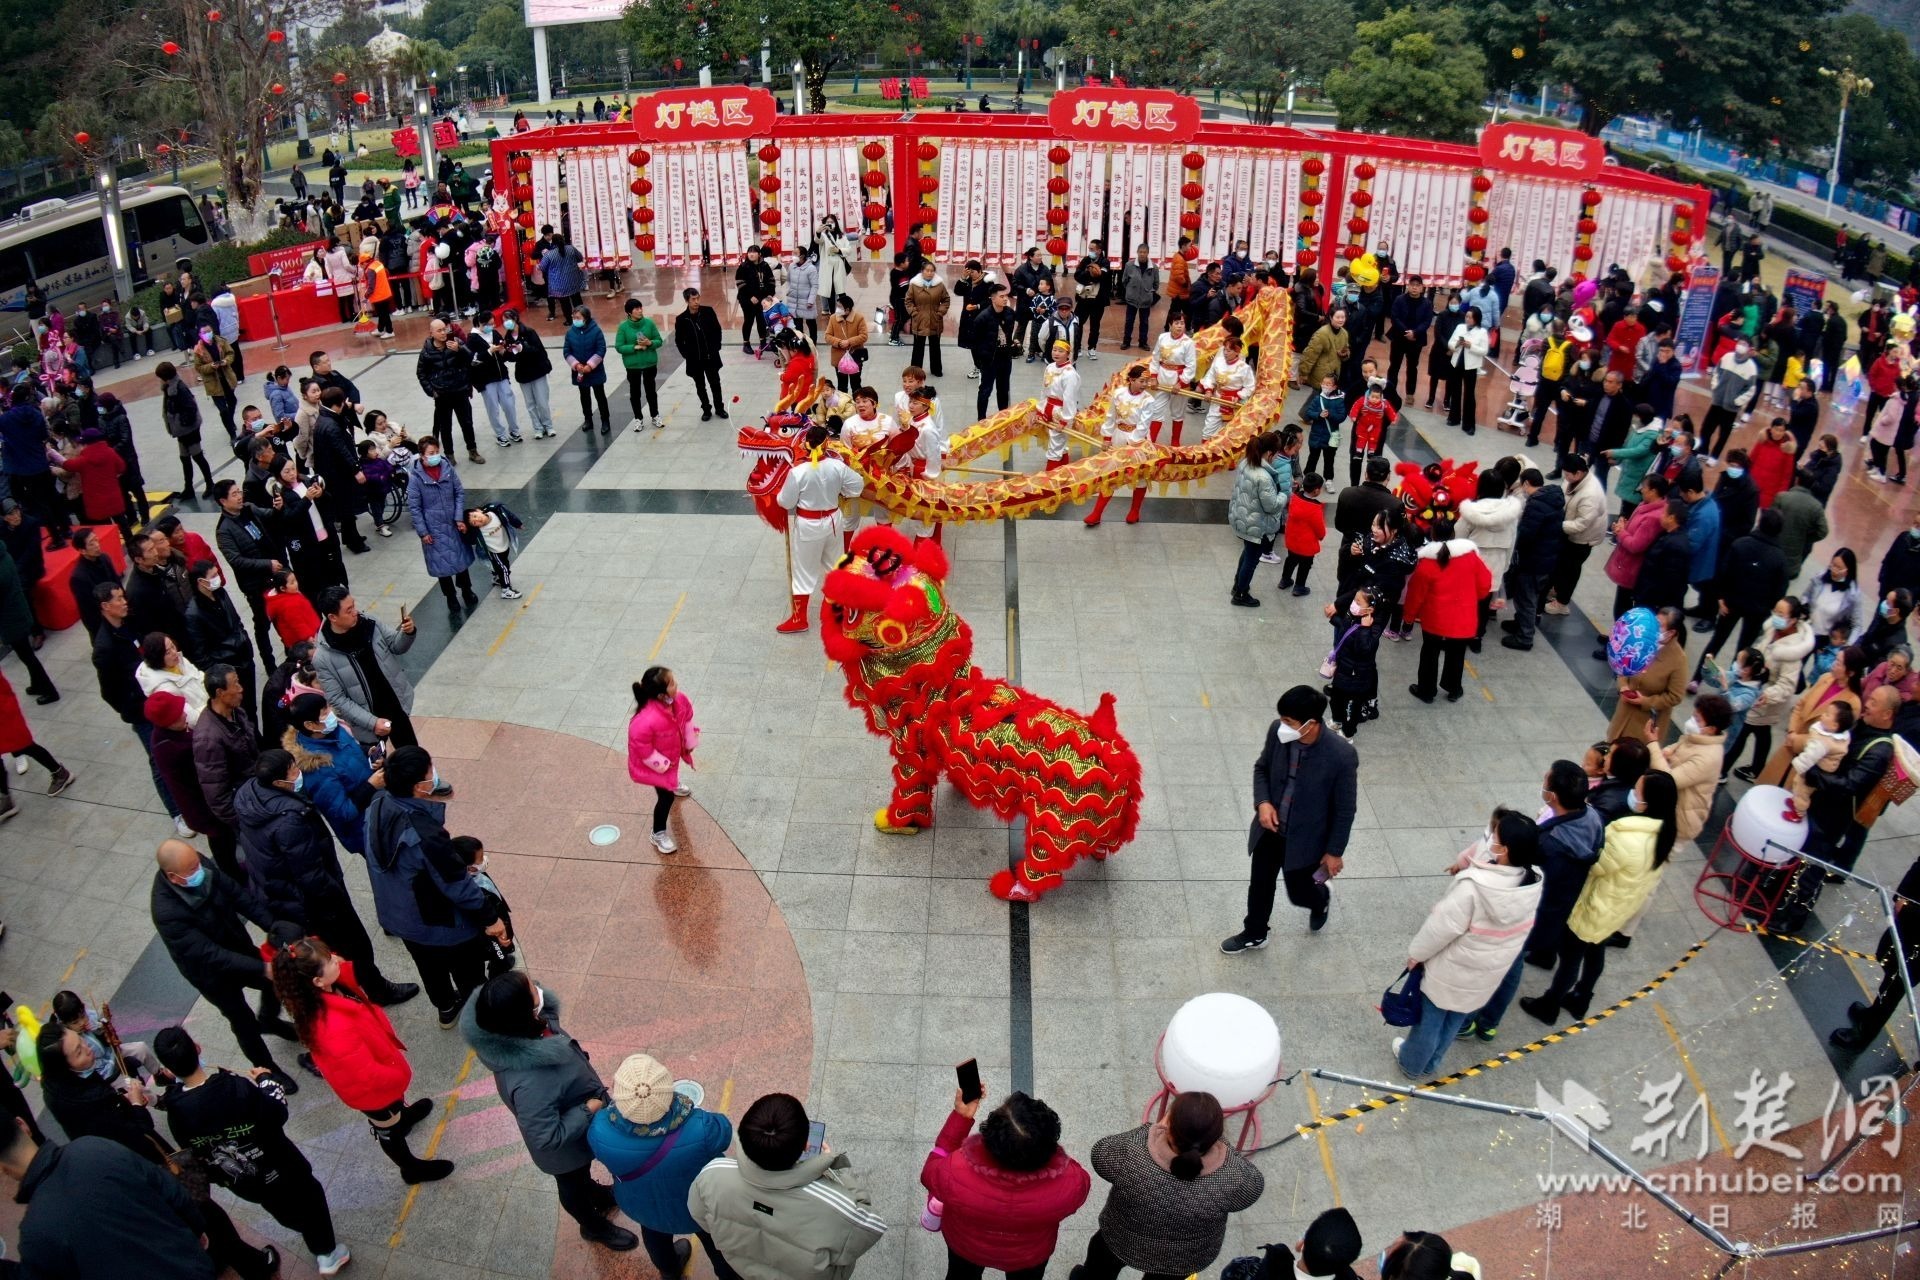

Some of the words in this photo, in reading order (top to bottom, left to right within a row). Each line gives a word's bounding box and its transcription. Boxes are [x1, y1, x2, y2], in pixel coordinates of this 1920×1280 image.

[655, 98, 753, 129] 灯谜区
[1072, 99, 1177, 132] 灯谜区
[391, 121, 459, 158] 爱国
[1499, 133, 1586, 170] 灯谜区
[783, 167, 792, 228] 千里通电话
[799, 167, 808, 228] 武大郎设宴
[1112, 173, 1122, 233] 快刀斩乱麻
